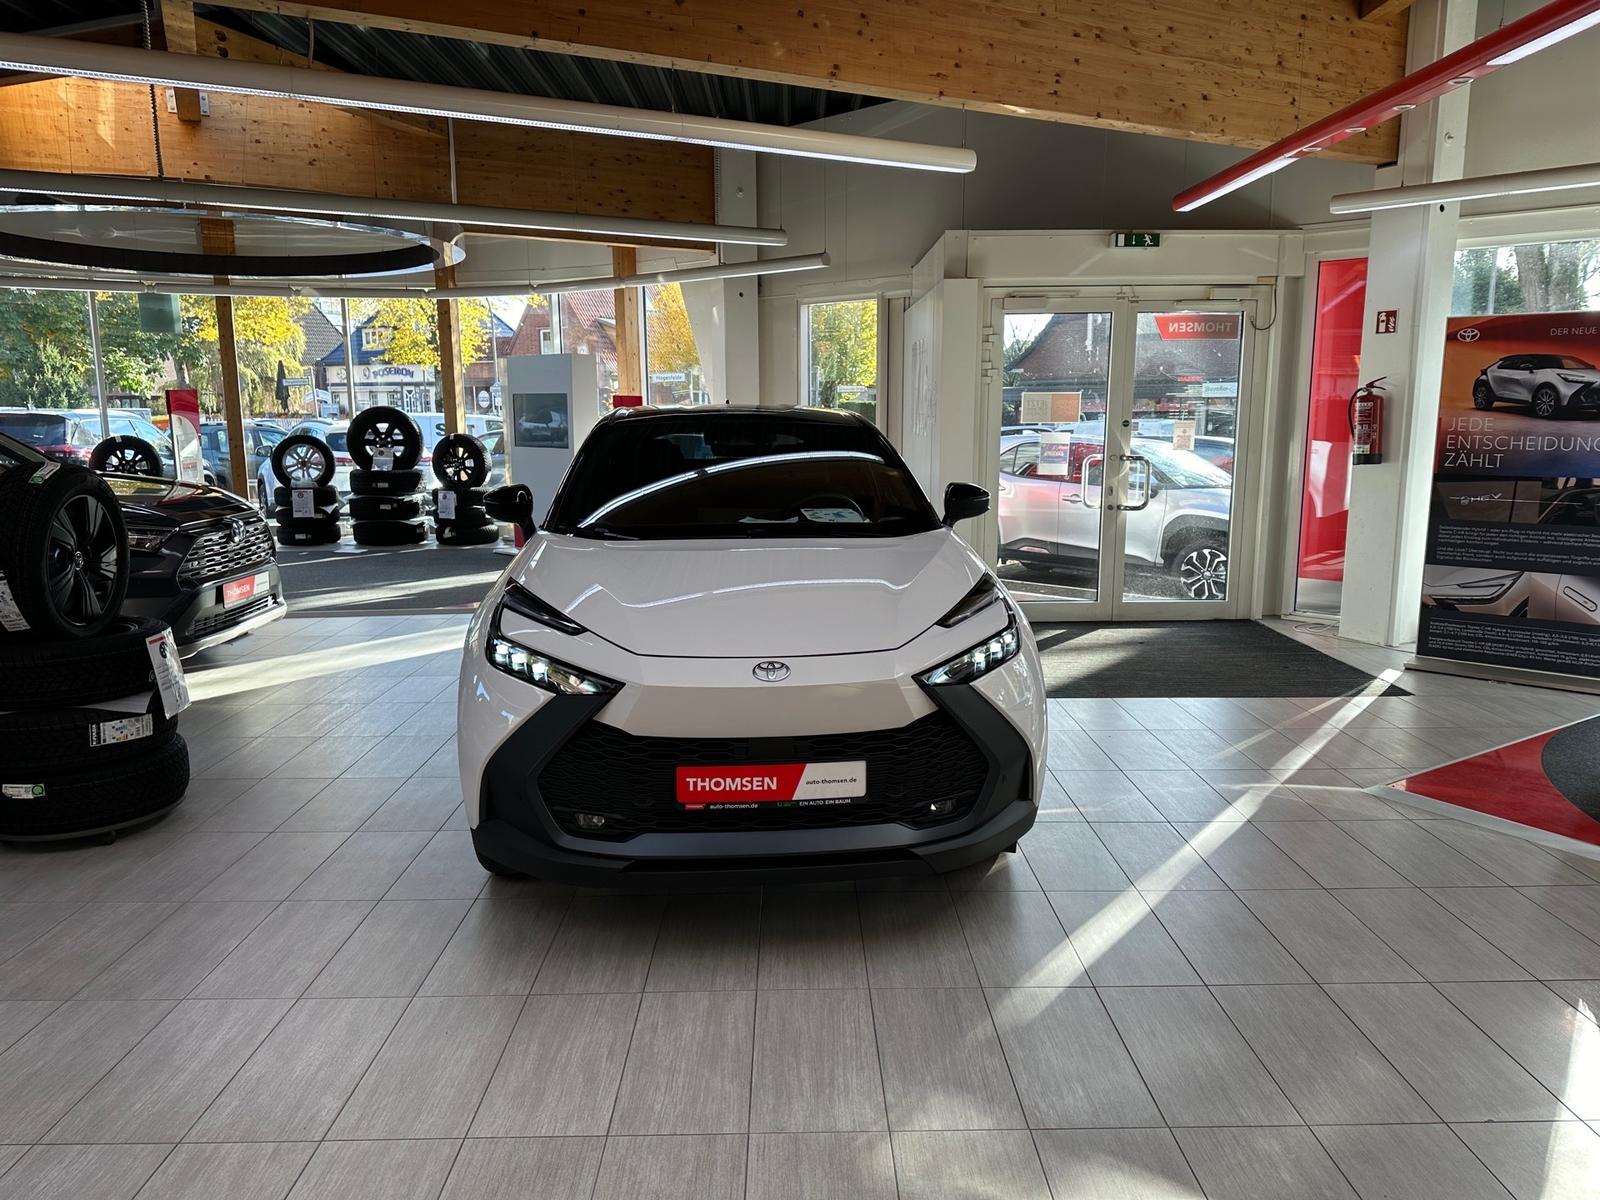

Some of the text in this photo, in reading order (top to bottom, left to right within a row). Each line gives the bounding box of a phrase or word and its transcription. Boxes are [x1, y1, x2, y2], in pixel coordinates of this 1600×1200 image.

[1550, 326, 1598, 336] DER NEUE
[1447, 416, 1495, 432] JEDE
[1444, 450, 1504, 468] ZÄHLT
[686, 776, 857, 793] THOMSEN auto-thomsen.de
[709, 802, 758, 810] auto-thomsen.de
